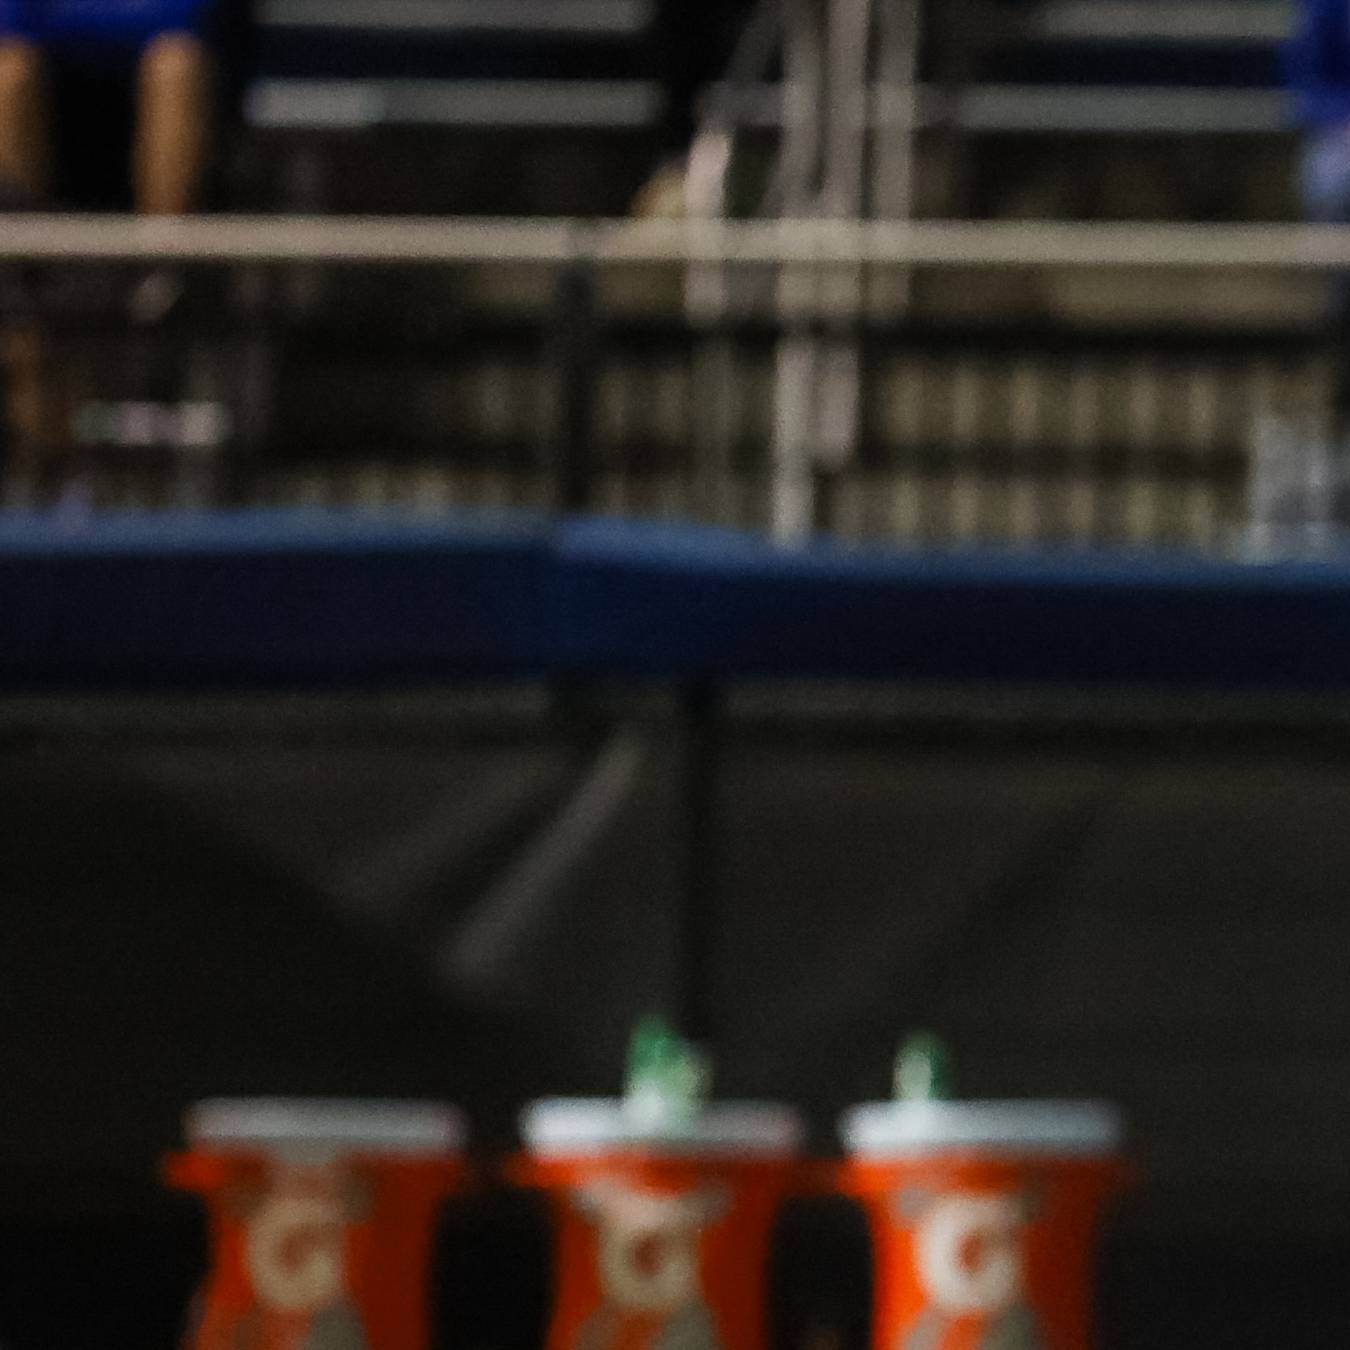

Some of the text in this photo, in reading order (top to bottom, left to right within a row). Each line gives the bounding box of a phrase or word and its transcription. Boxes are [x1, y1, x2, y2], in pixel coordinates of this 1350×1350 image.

[244, 1200, 346, 1315] G
[602, 1200, 702, 1315] G
[916, 1194, 1024, 1315] G
